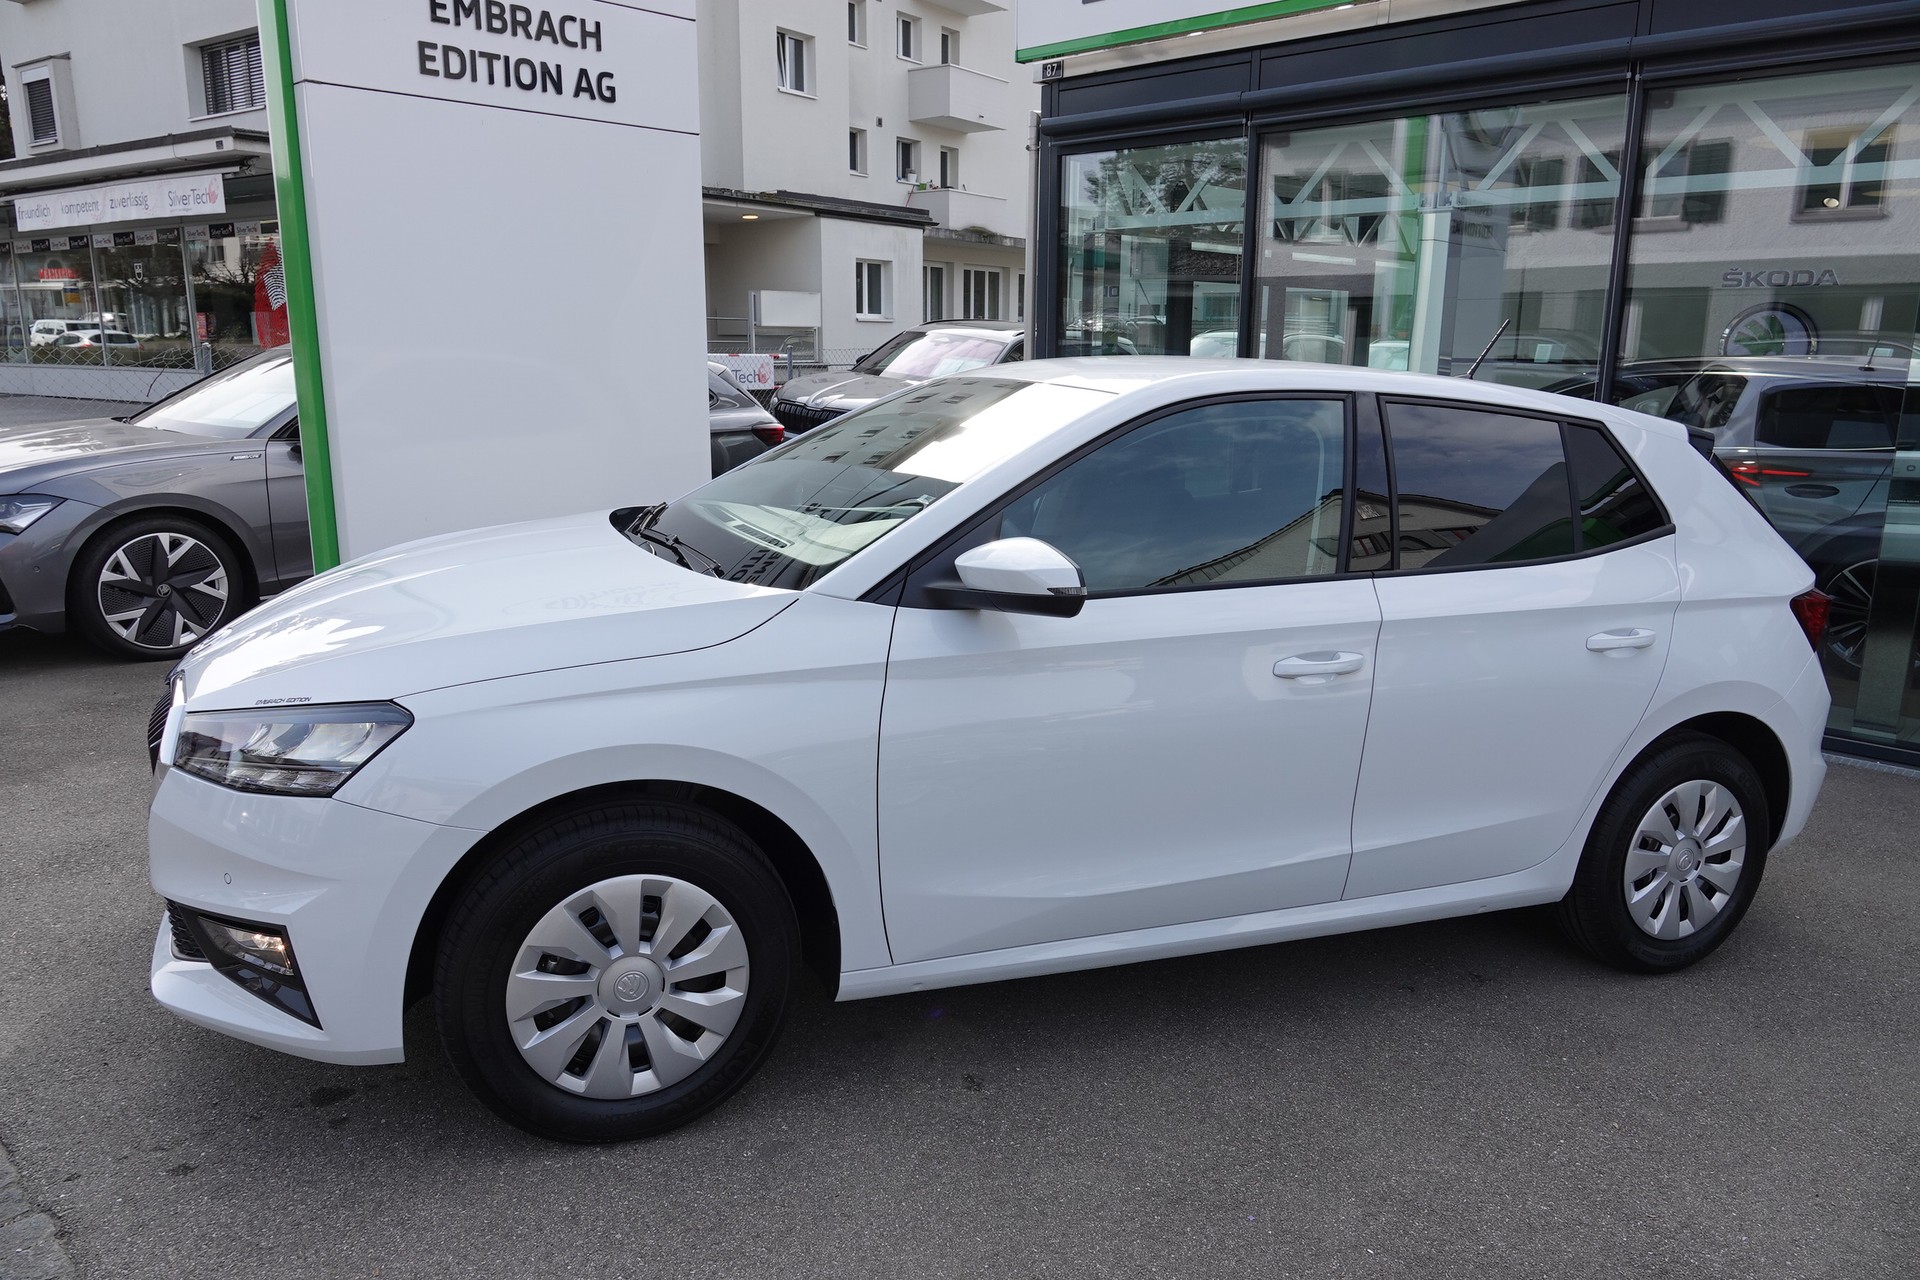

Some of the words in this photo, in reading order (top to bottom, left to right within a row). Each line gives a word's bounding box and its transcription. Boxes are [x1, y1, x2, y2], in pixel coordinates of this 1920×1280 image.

[429, 0, 602, 52] EMBRACH
[417, 40, 563, 96] EDITION
[573, 67, 617, 104] AG
[1047, 64, 1058, 77] 87
[60, 201, 100, 218] kompetent
[1721, 267, 1840, 288] ŠKODA
